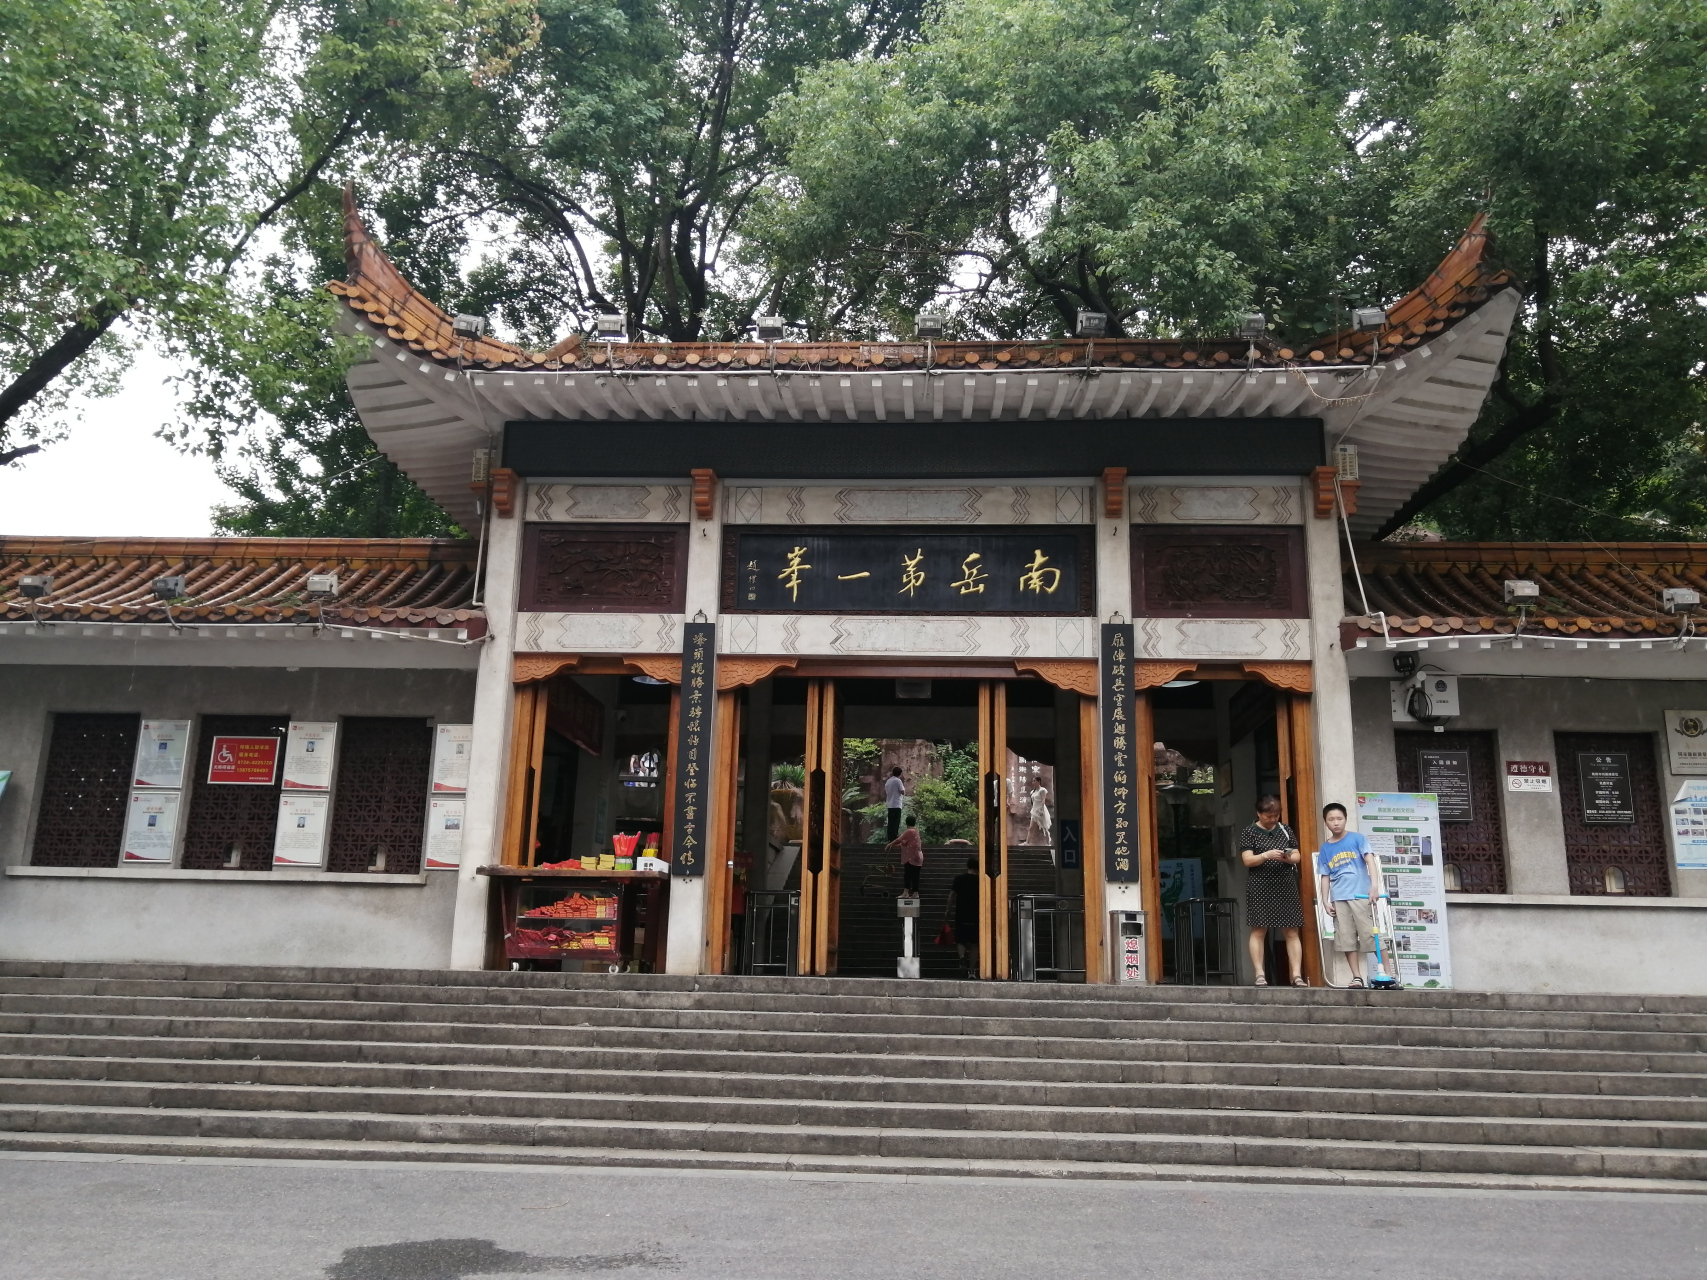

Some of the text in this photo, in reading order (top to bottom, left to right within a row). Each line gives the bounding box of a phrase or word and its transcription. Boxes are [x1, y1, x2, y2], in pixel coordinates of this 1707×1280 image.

[1510, 764, 1547, 773] 遵德守礼
[1063, 826, 1077, 864] 入口
[1125, 938, 1140, 979] 熄烟处
